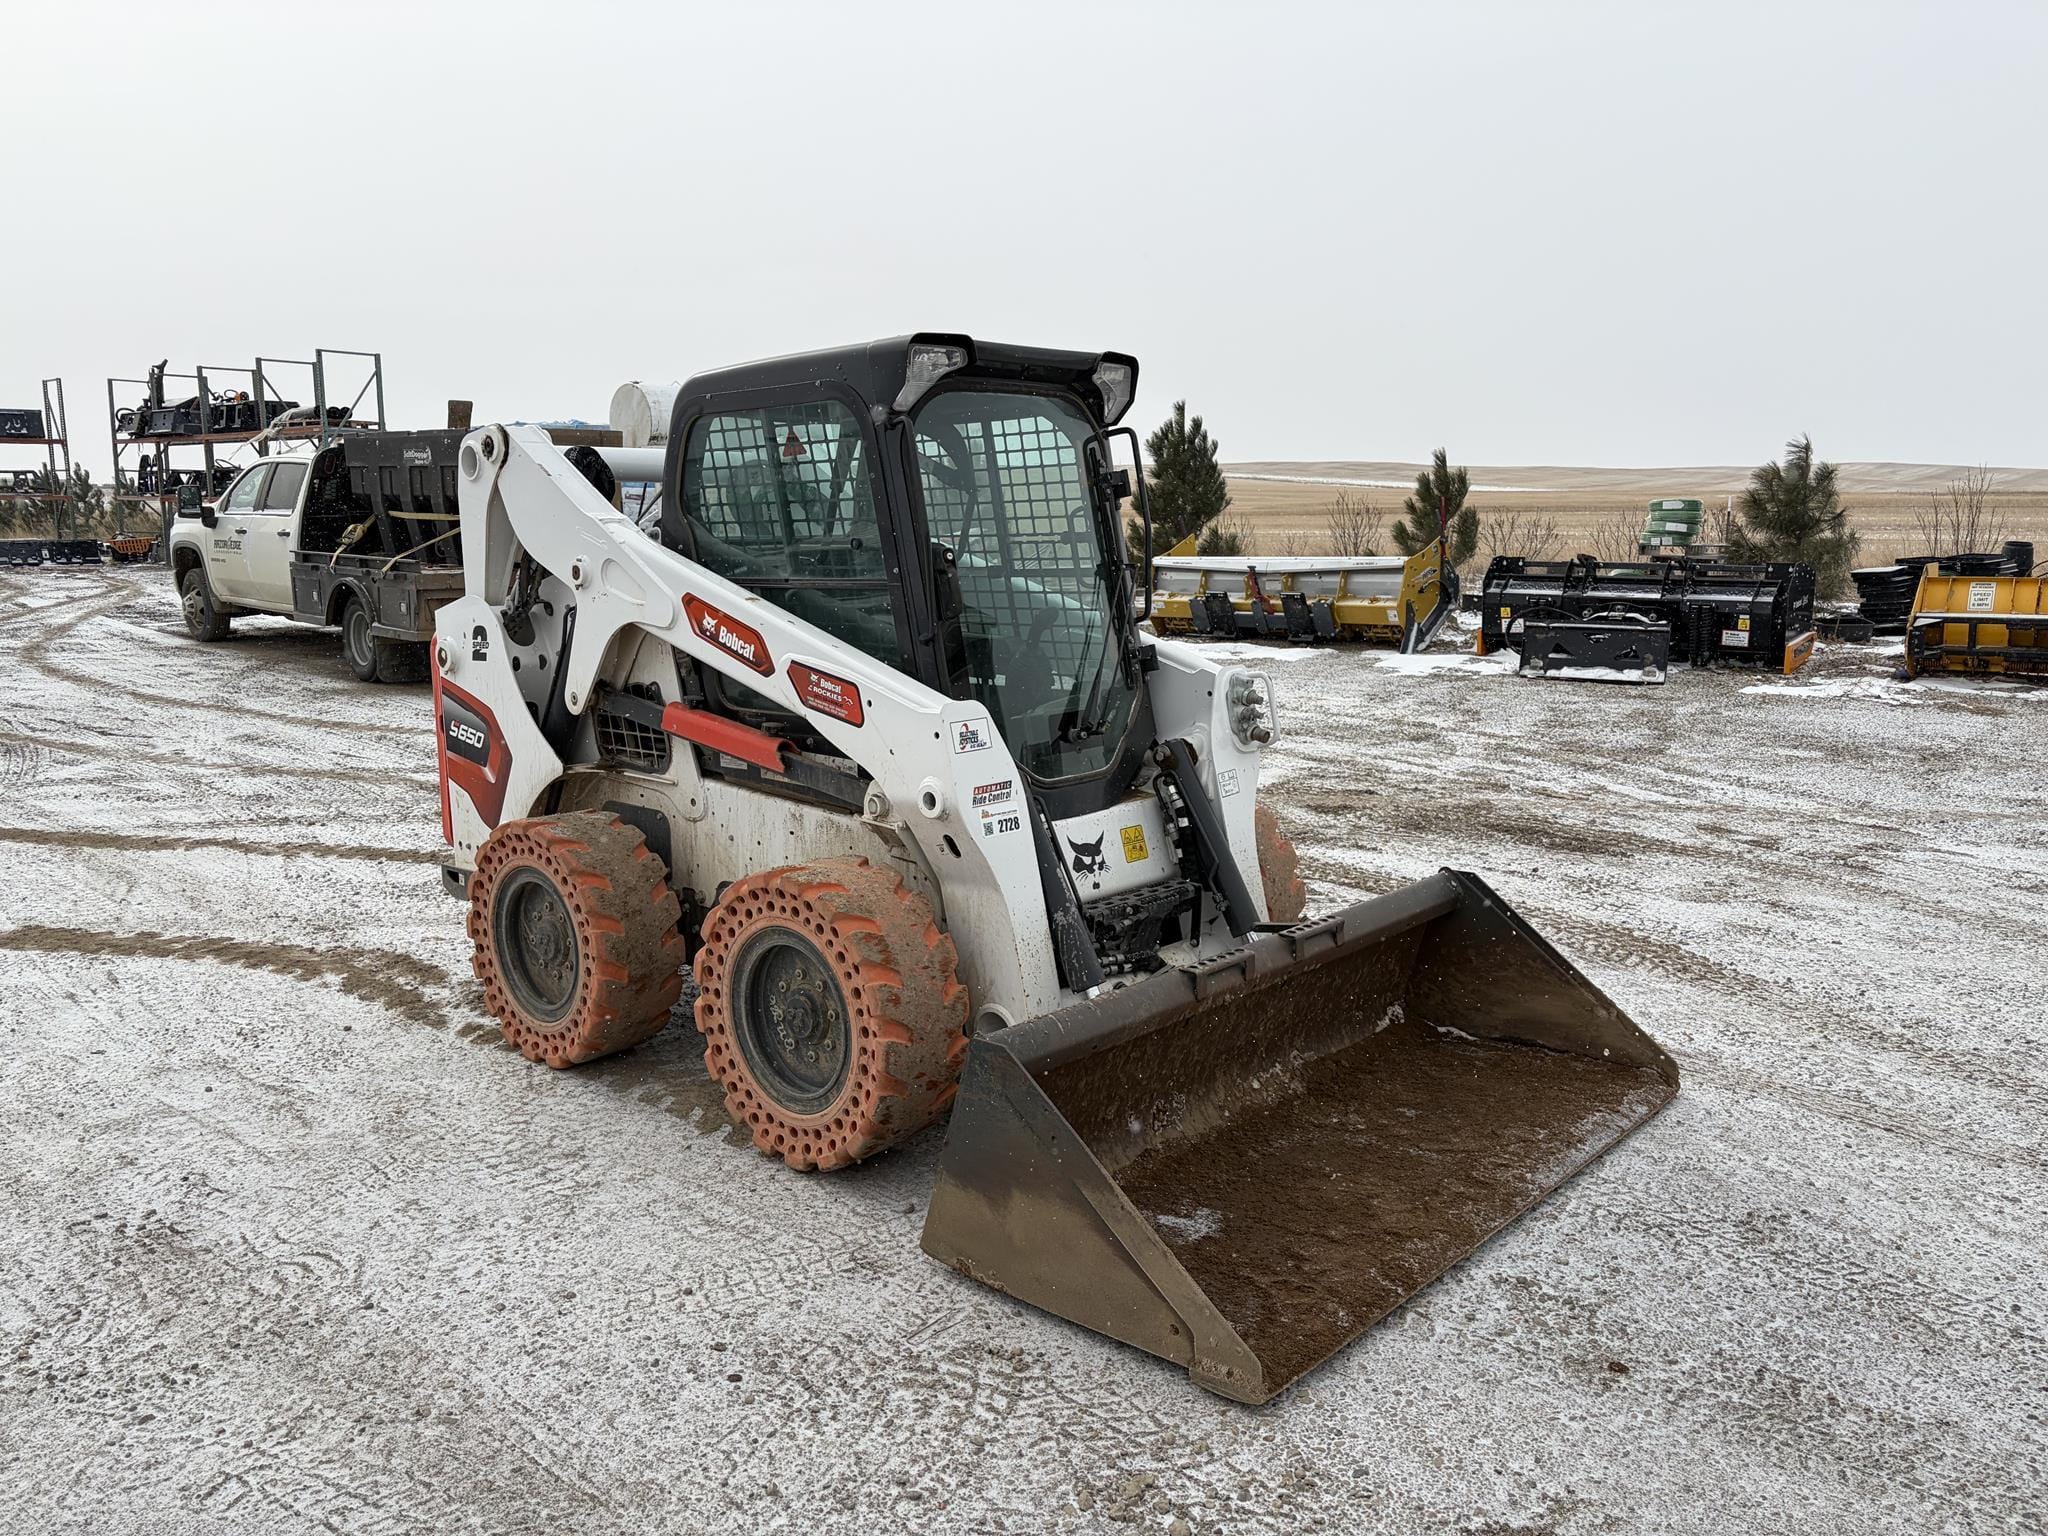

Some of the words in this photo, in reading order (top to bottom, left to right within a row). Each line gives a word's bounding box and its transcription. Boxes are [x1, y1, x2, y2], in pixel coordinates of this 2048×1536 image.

[230, 540, 242, 550] EDGE
[472, 641, 489, 649] SPEED
[718, 625, 755, 661] Bobcat
[813, 686, 843, 702] ROCKIES
[820, 678, 842, 694] Bobcat
[449, 720, 485, 749] S650
[974, 781, 1012, 795] AUTOMATIC
[972, 794, 987, 806] Ride
[988, 789, 1012, 803] Control
[997, 816, 1020, 833] 2728
